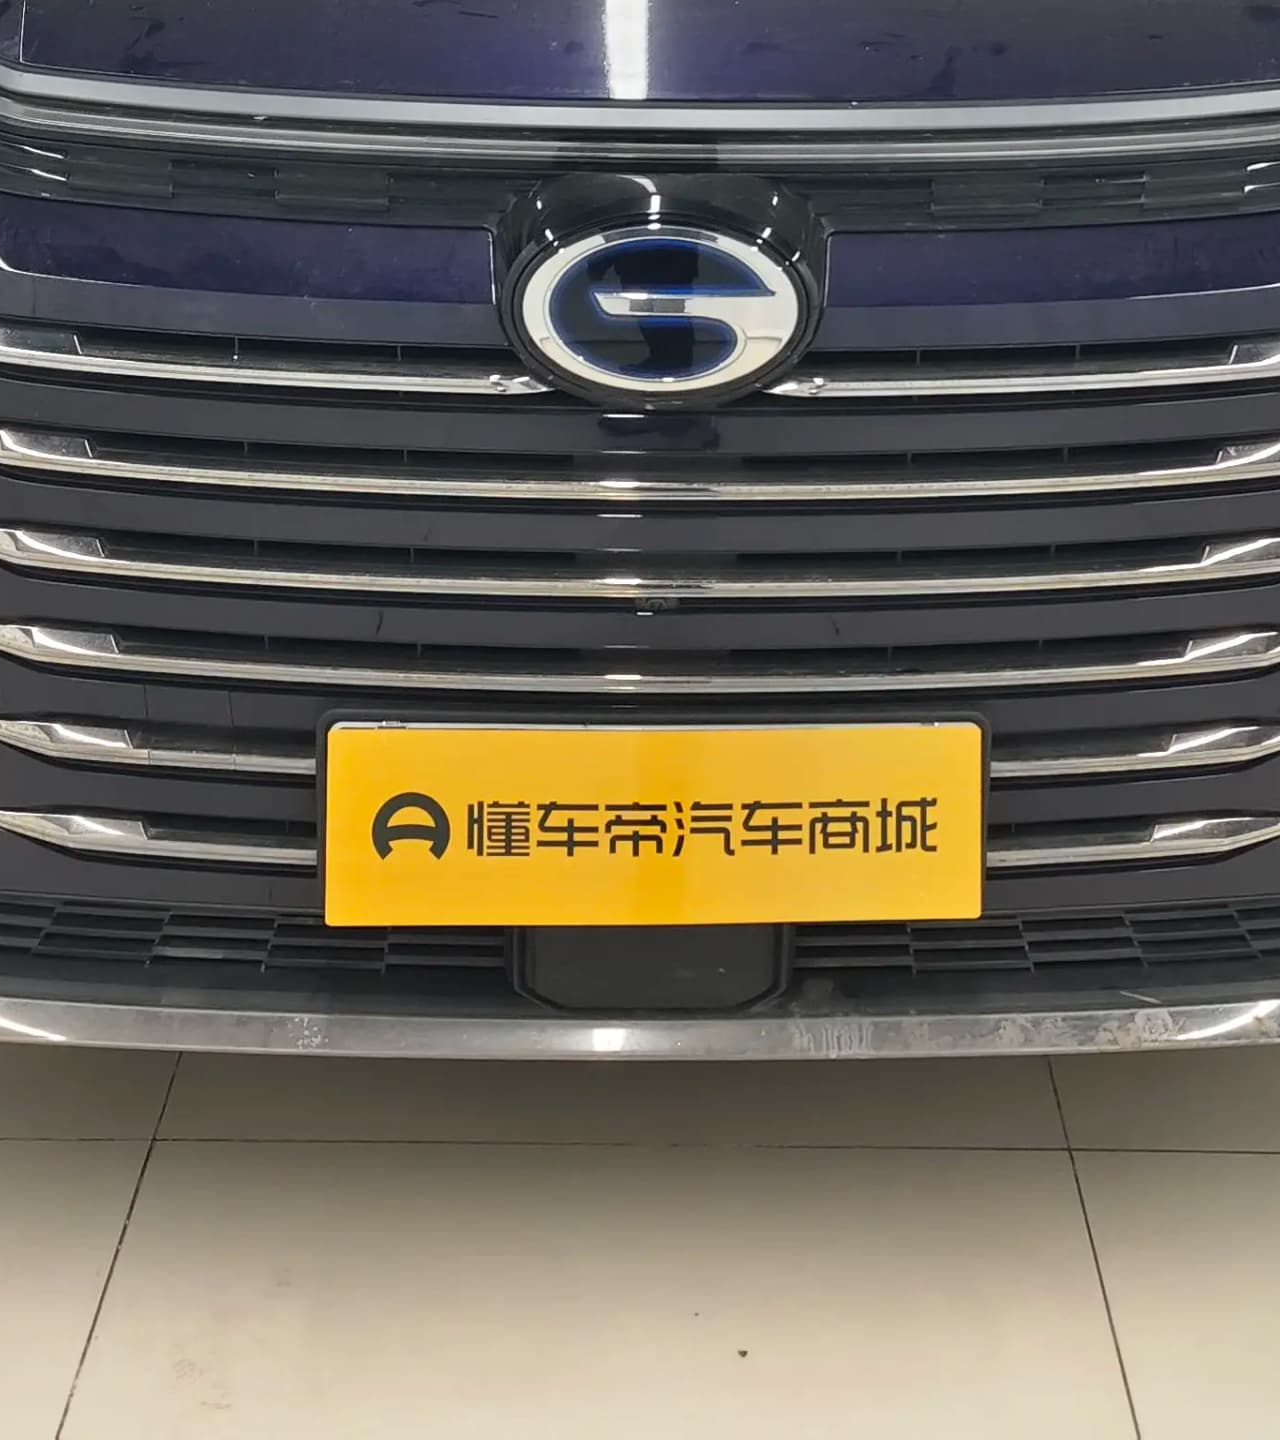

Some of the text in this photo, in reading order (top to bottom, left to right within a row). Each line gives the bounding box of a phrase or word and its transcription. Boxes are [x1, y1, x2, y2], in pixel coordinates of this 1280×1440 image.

[466, 796, 938, 857] 懂车帝汽车商城
